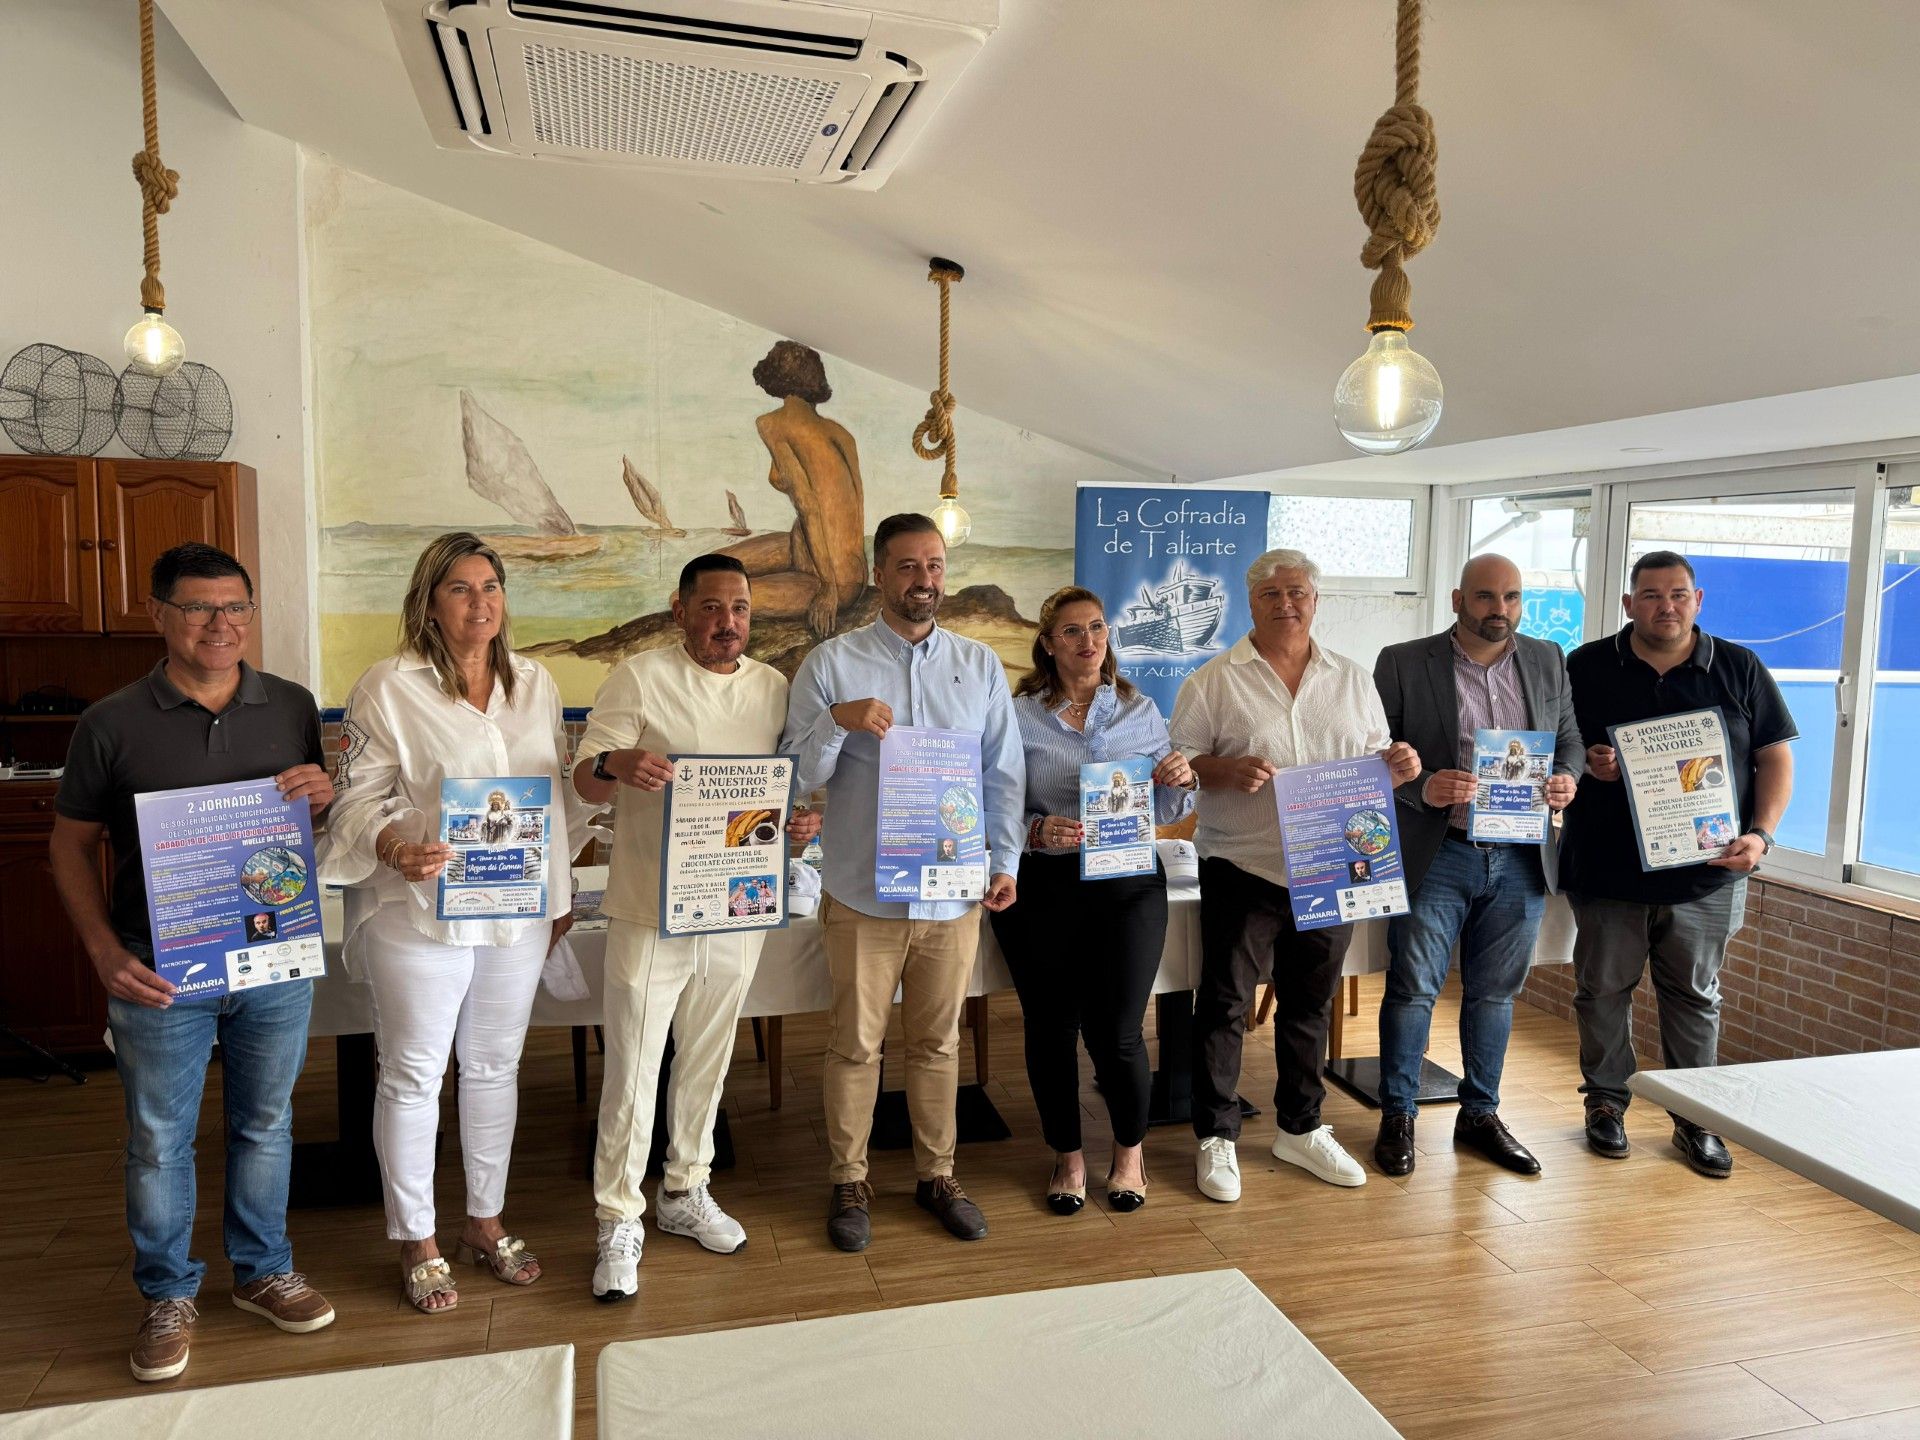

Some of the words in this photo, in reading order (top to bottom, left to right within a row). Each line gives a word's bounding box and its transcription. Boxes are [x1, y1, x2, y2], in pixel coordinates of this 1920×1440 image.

[1097, 498, 1129, 527] La
[1138, 498, 1246, 528] Cofradía
[1104, 529, 1133, 554] de
[1140, 530, 1237, 558] Taliarte
[1119, 666, 1196, 678] STAURA
[1637, 719, 1697, 736] HOMENAJE
[1640, 737, 1647, 745] A
[1648, 728, 1700, 744] NUESTROS
[912, 738, 916, 746] 2
[918, 739, 955, 749] JORNADAS
[1644, 737, 1703, 755] MAYORES
[700, 766, 768, 776] HOMENAJE
[1307, 775, 1311, 783] 2
[1314, 768, 1358, 782] JORNADAS
[698, 778, 706, 786] A
[709, 777, 768, 786] NUESTROS
[699, 787, 766, 799] MAYORES
[187, 803, 194, 813] 2
[199, 793, 262, 812] JORNADAS
[1654, 797, 1682, 805] MERIENDA
[1648, 804, 1682, 812] CHOCOLATE
[225, 820, 260, 830] NUESTROS
[262, 816, 286, 825] MARES
[187, 838, 195, 846] 19
[198, 836, 208, 845] DE
[208, 831, 230, 843] JULIO
[231, 830, 241, 839] DE
[242, 836, 266, 846] MUELLE
[276, 832, 302, 841] TALIARTE
[285, 838, 302, 847] TELDE
[467, 864, 487, 874] Virgen
[499, 862, 522, 871] Carmen
[681, 860, 720, 868] CHOCOLATE
[1298, 910, 1338, 921] AQUANARIA
[176, 978, 225, 994] UANARIA
